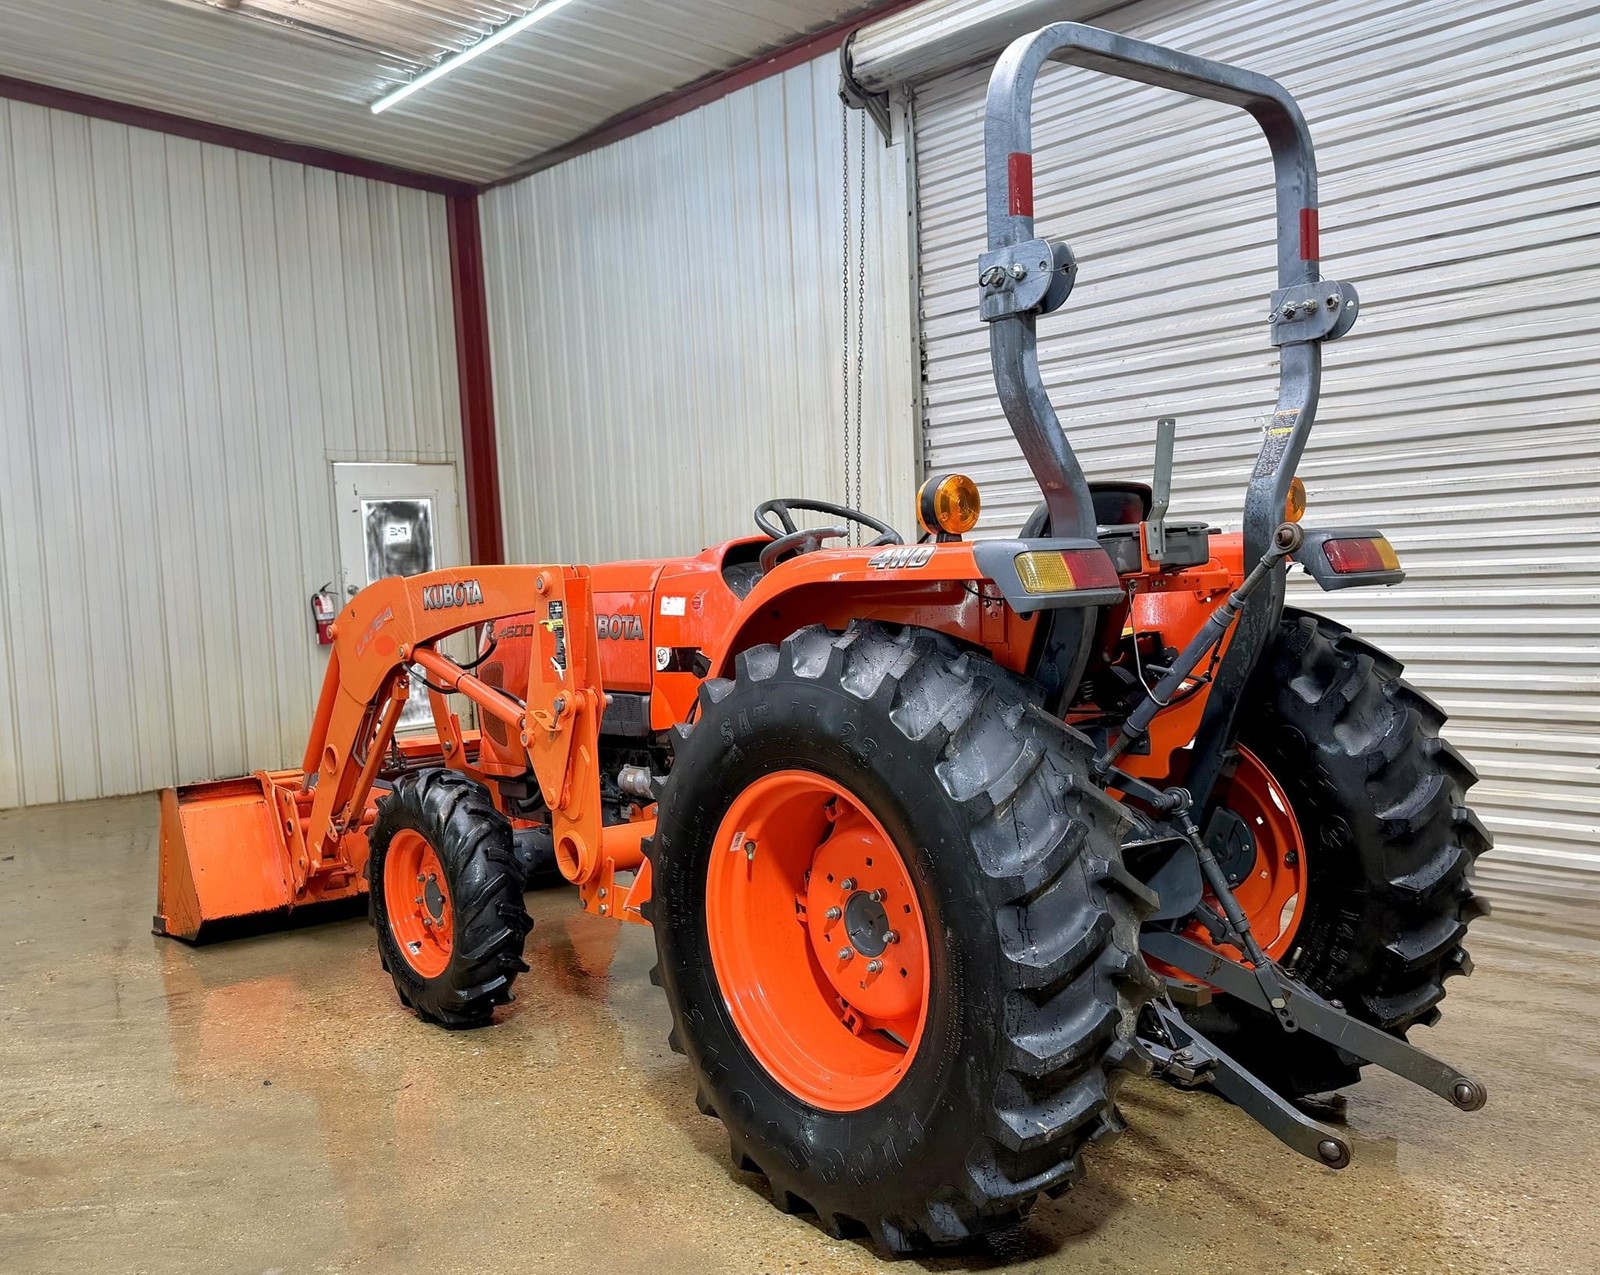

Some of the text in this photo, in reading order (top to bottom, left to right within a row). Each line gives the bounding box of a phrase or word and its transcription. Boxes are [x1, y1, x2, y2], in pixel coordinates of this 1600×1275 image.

[868, 545, 937, 570] 4WD
[423, 579, 484, 610] KUBOTA
[595, 614, 645, 641] BOTA
